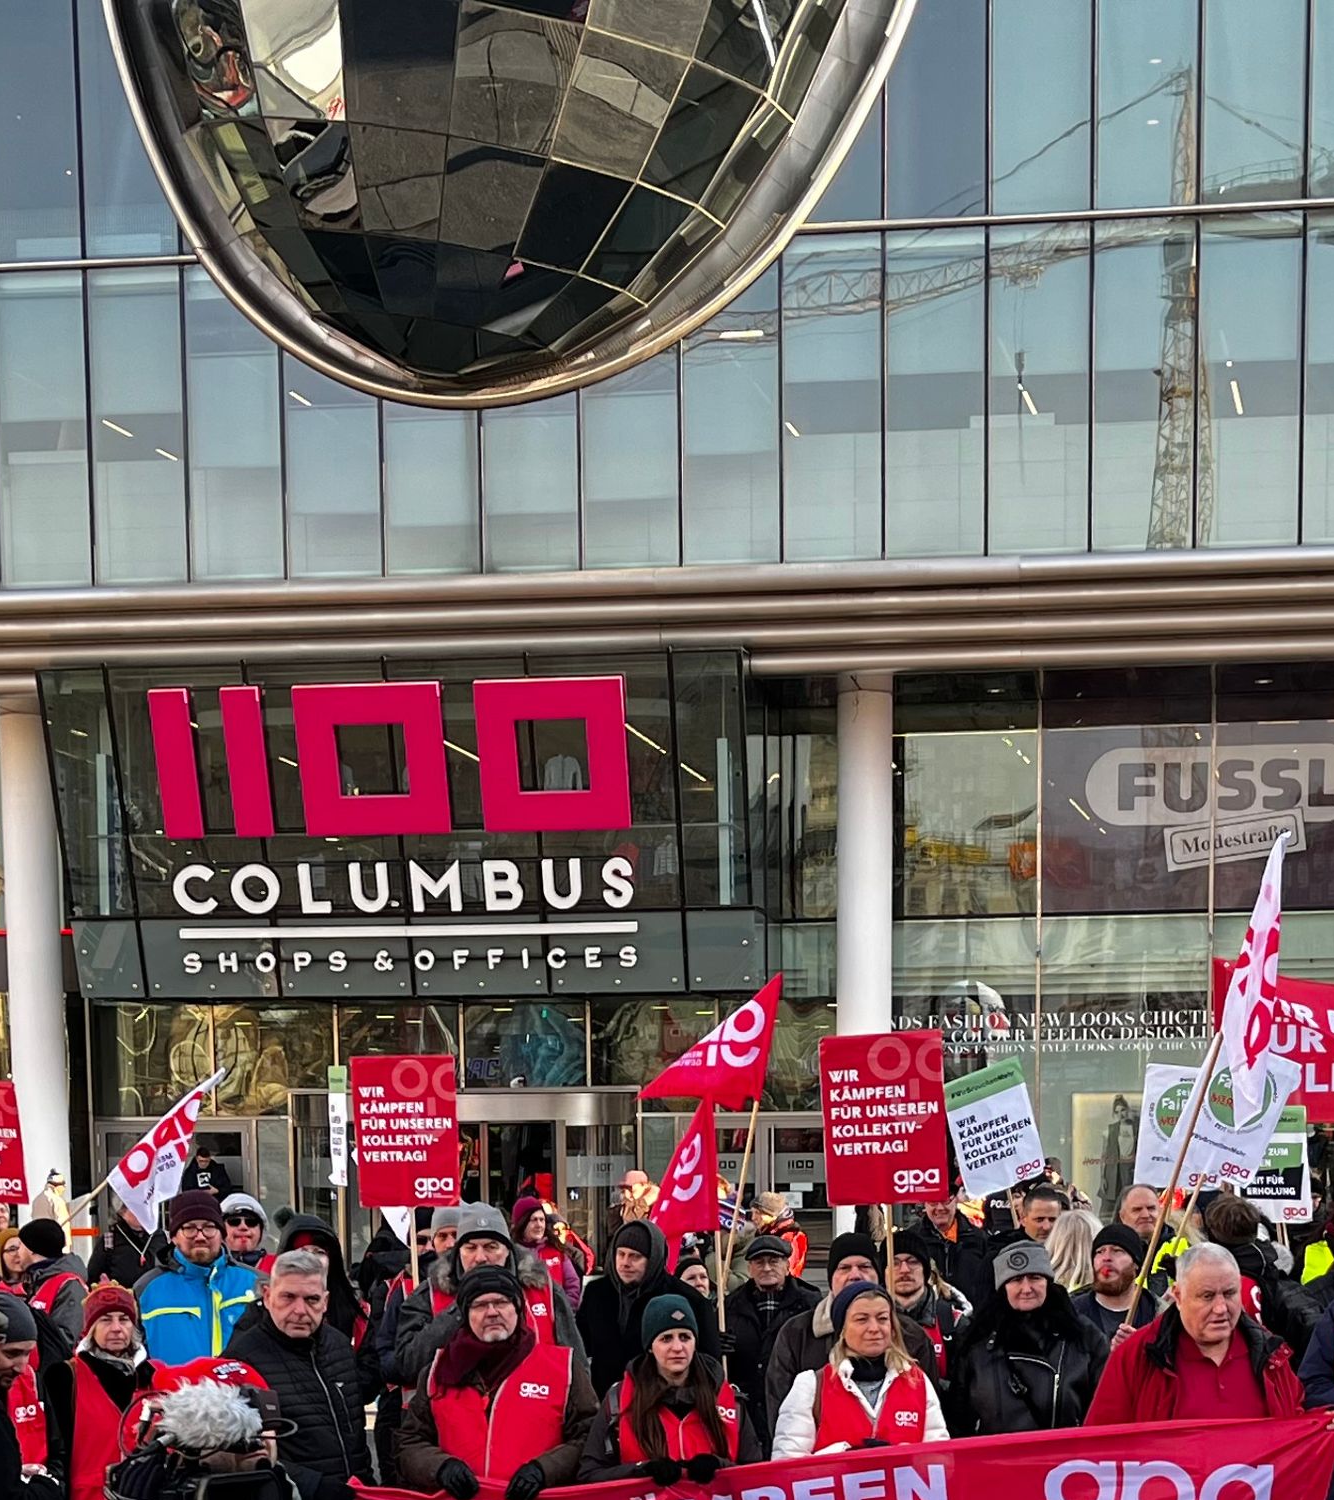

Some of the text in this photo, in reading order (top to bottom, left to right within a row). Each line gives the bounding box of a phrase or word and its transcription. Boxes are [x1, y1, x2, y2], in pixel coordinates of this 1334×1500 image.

[172, 856, 636, 916] COLUMBUS
[184, 945, 638, 974] SHOPS & OFFICES
[828, 1069, 859, 1083] WIR
[359, 1086, 385, 1098] WIR
[830, 1084, 906, 1102] KÄMPFEN
[360, 1100, 424, 1114] KÄMPFEN
[831, 1101, 939, 1121] FÜR UNSEREN
[361, 1116, 453, 1130] FÜR UNSEREN
[832, 1121, 923, 1138] KOLLEKTIV-
[956, 1114, 978, 1129] WIR
[958, 1114, 1010, 1140] KÄMPFEN
[362, 1134, 440, 1146] KOLLEKTIV-
[961, 1116, 1032, 1151] FÜR UNSEREN
[363, 1151, 428, 1163] VERTRAG!
[833, 1140, 909, 1156] VERTRAG!
[964, 1134, 1025, 1162] KOLLEKTIV-
[966, 1146, 1017, 1172] VERTRAG!
[1015, 1158, 1041, 1179] gpa
[1219, 1161, 1250, 1179] gpa
[414, 1177, 454, 1199] gpa
[893, 1169, 940, 1193] gpa
[1283, 1206, 1308, 1220] gpa
[519, 1382, 550, 1400] gpa
[894, 1410, 919, 1426] gpa
